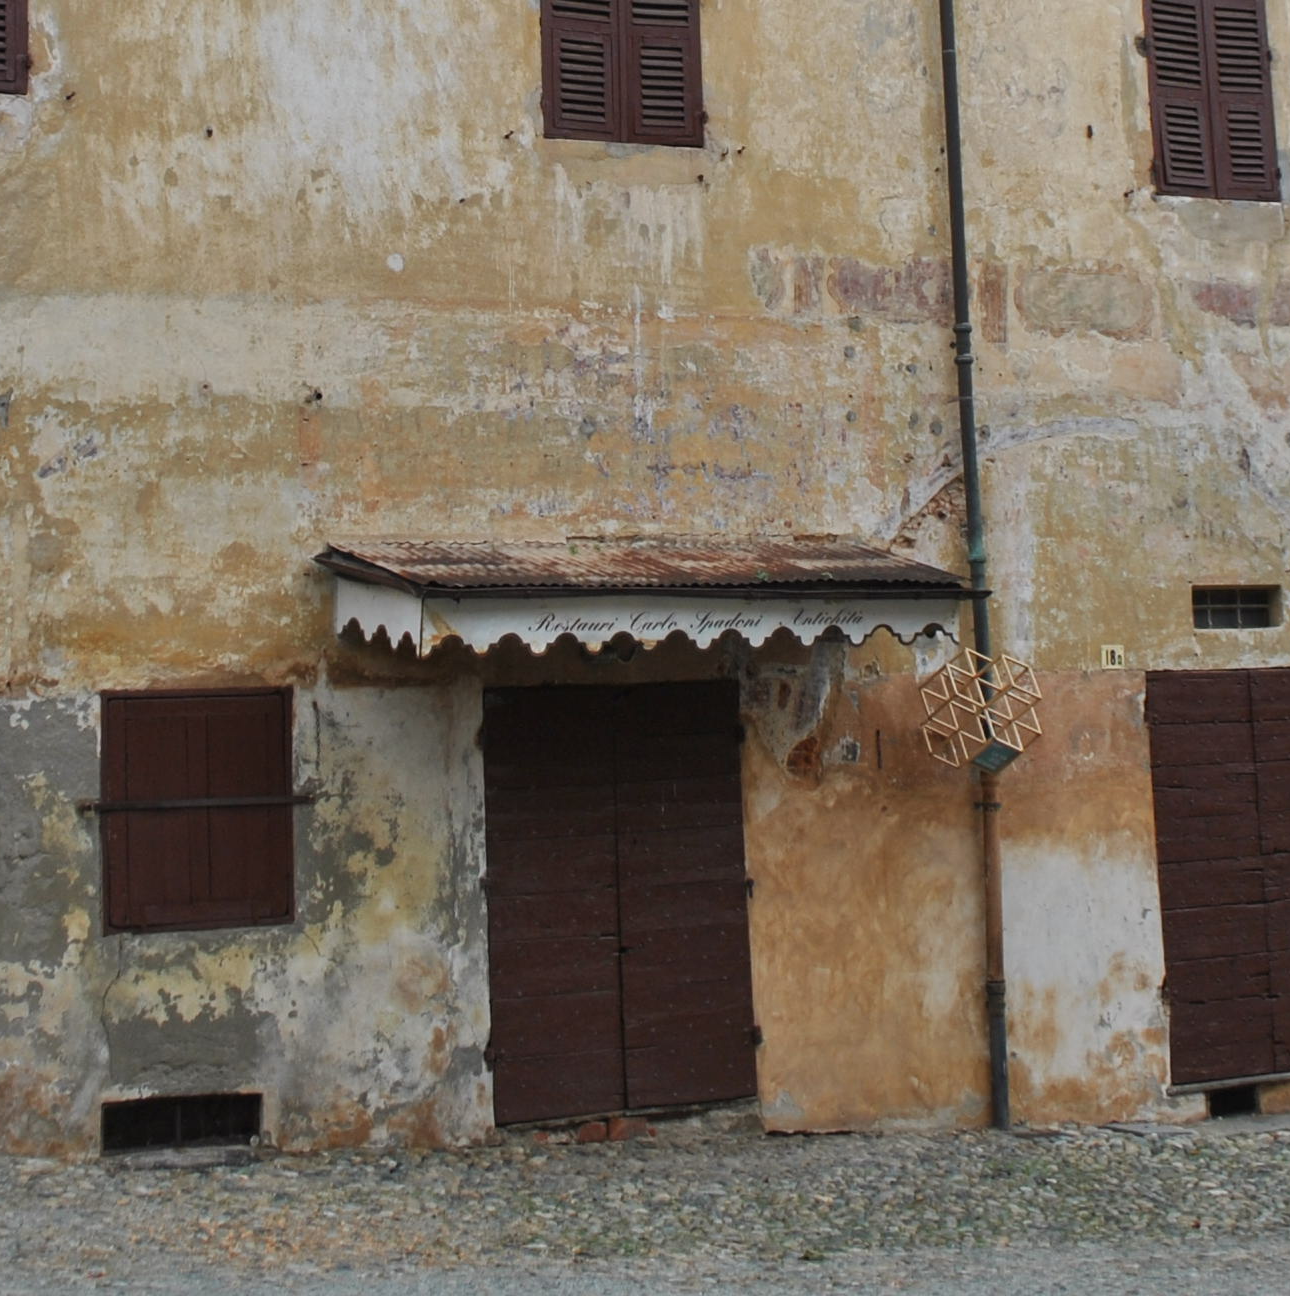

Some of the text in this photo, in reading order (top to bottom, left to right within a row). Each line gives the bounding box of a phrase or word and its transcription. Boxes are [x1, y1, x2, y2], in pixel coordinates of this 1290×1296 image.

[528, 612, 619, 632] Restauri
[630, 611, 678, 633] Carlo
[690, 611, 763, 634] Spadoni
